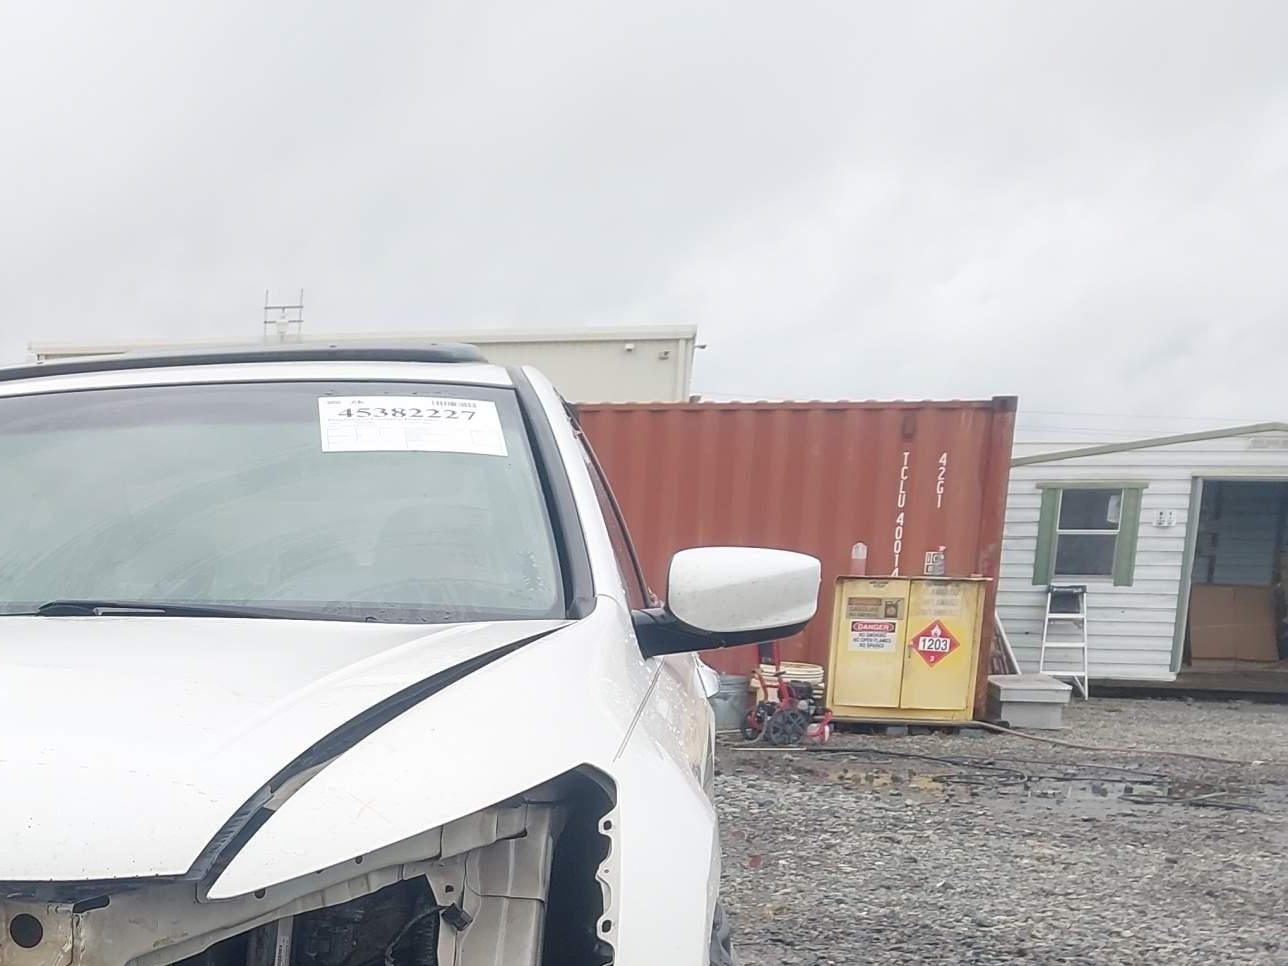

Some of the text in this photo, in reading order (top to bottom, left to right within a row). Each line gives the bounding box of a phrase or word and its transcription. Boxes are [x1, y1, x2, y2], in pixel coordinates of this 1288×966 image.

[338, 407, 476, 421] 45382227
[897, 451, 910, 508] TCLU
[936, 452, 948, 508] 42G1
[857, 623, 890, 631] DANGER
[922, 638, 948, 651] 1203
